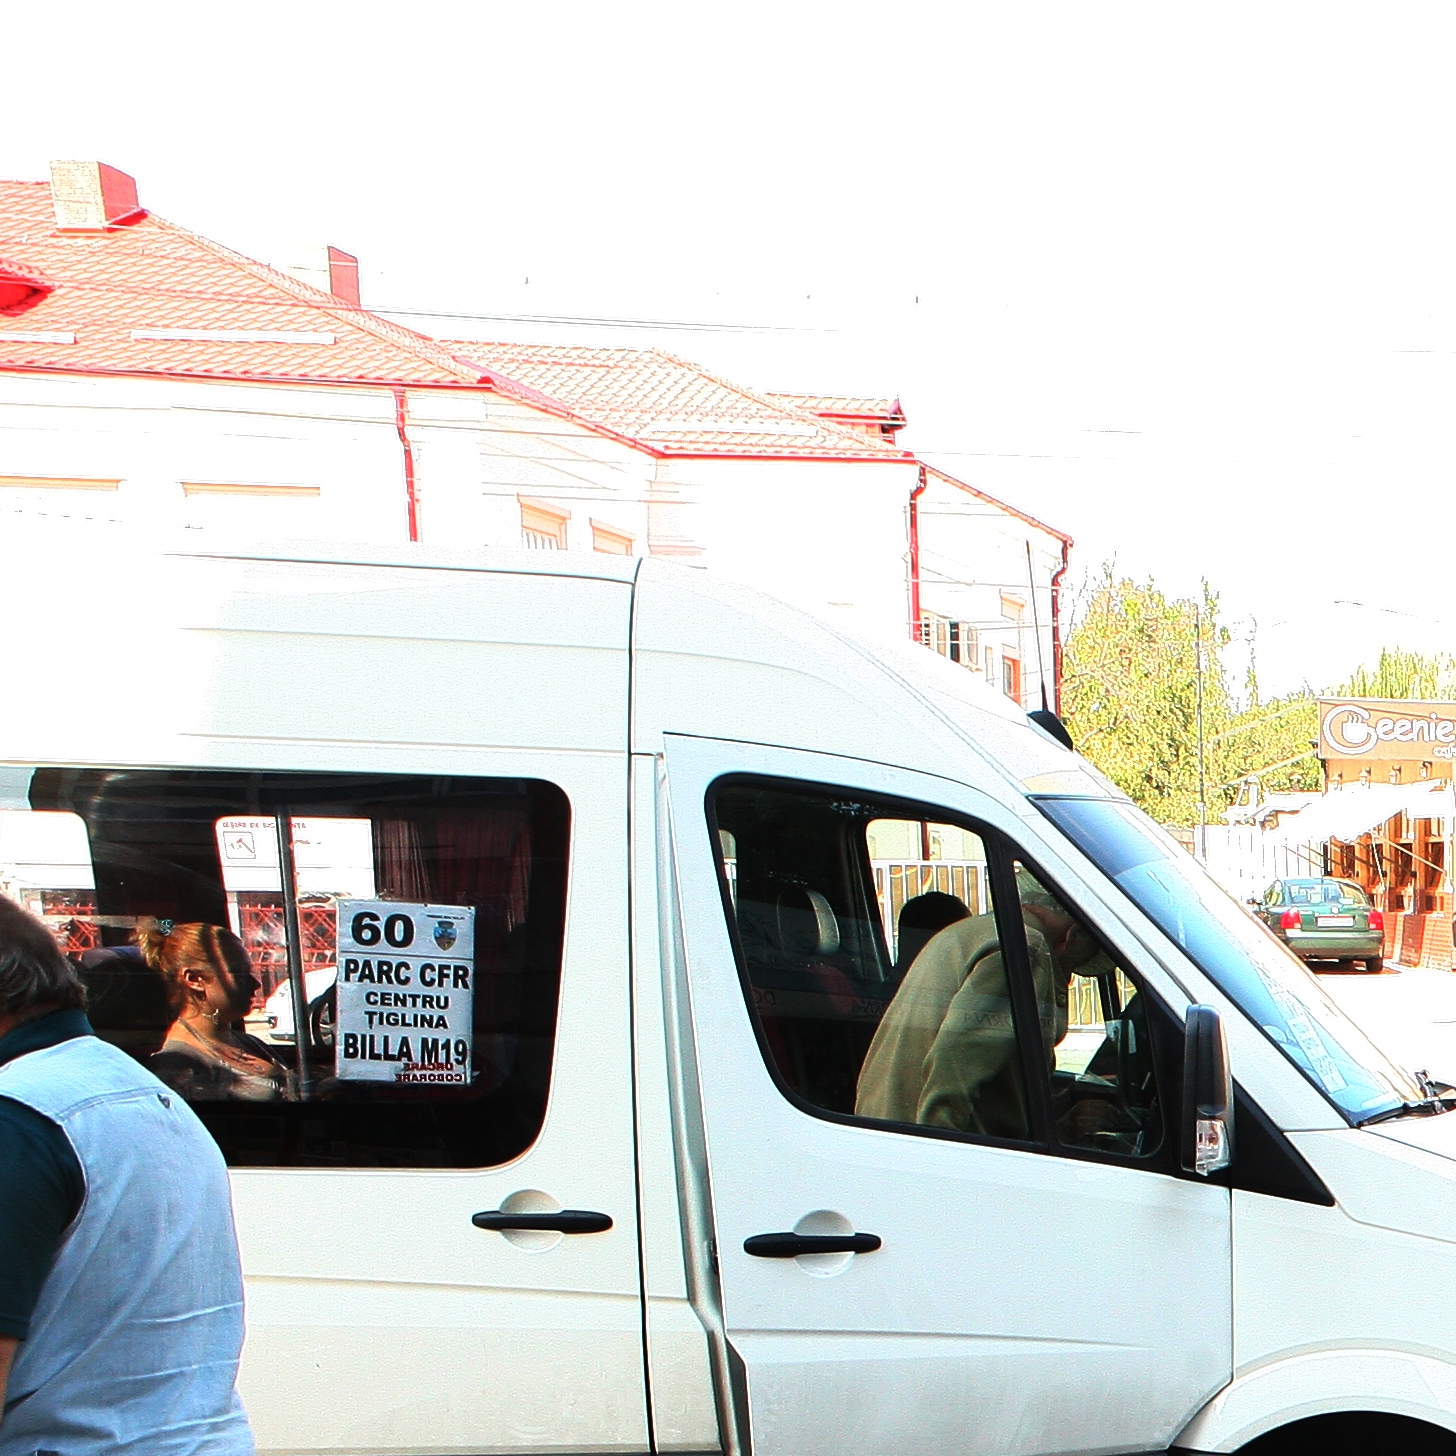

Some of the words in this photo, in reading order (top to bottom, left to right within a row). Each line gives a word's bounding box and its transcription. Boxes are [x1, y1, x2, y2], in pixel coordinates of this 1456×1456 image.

[351, 911, 415, 948] 60
[344, 958, 411, 986] PARC
[419, 963, 470, 990] CFR
[365, 991, 450, 1010] CENTRU
[343, 1032, 414, 1063] BILLA
[420, 1036, 468, 1066] M19
